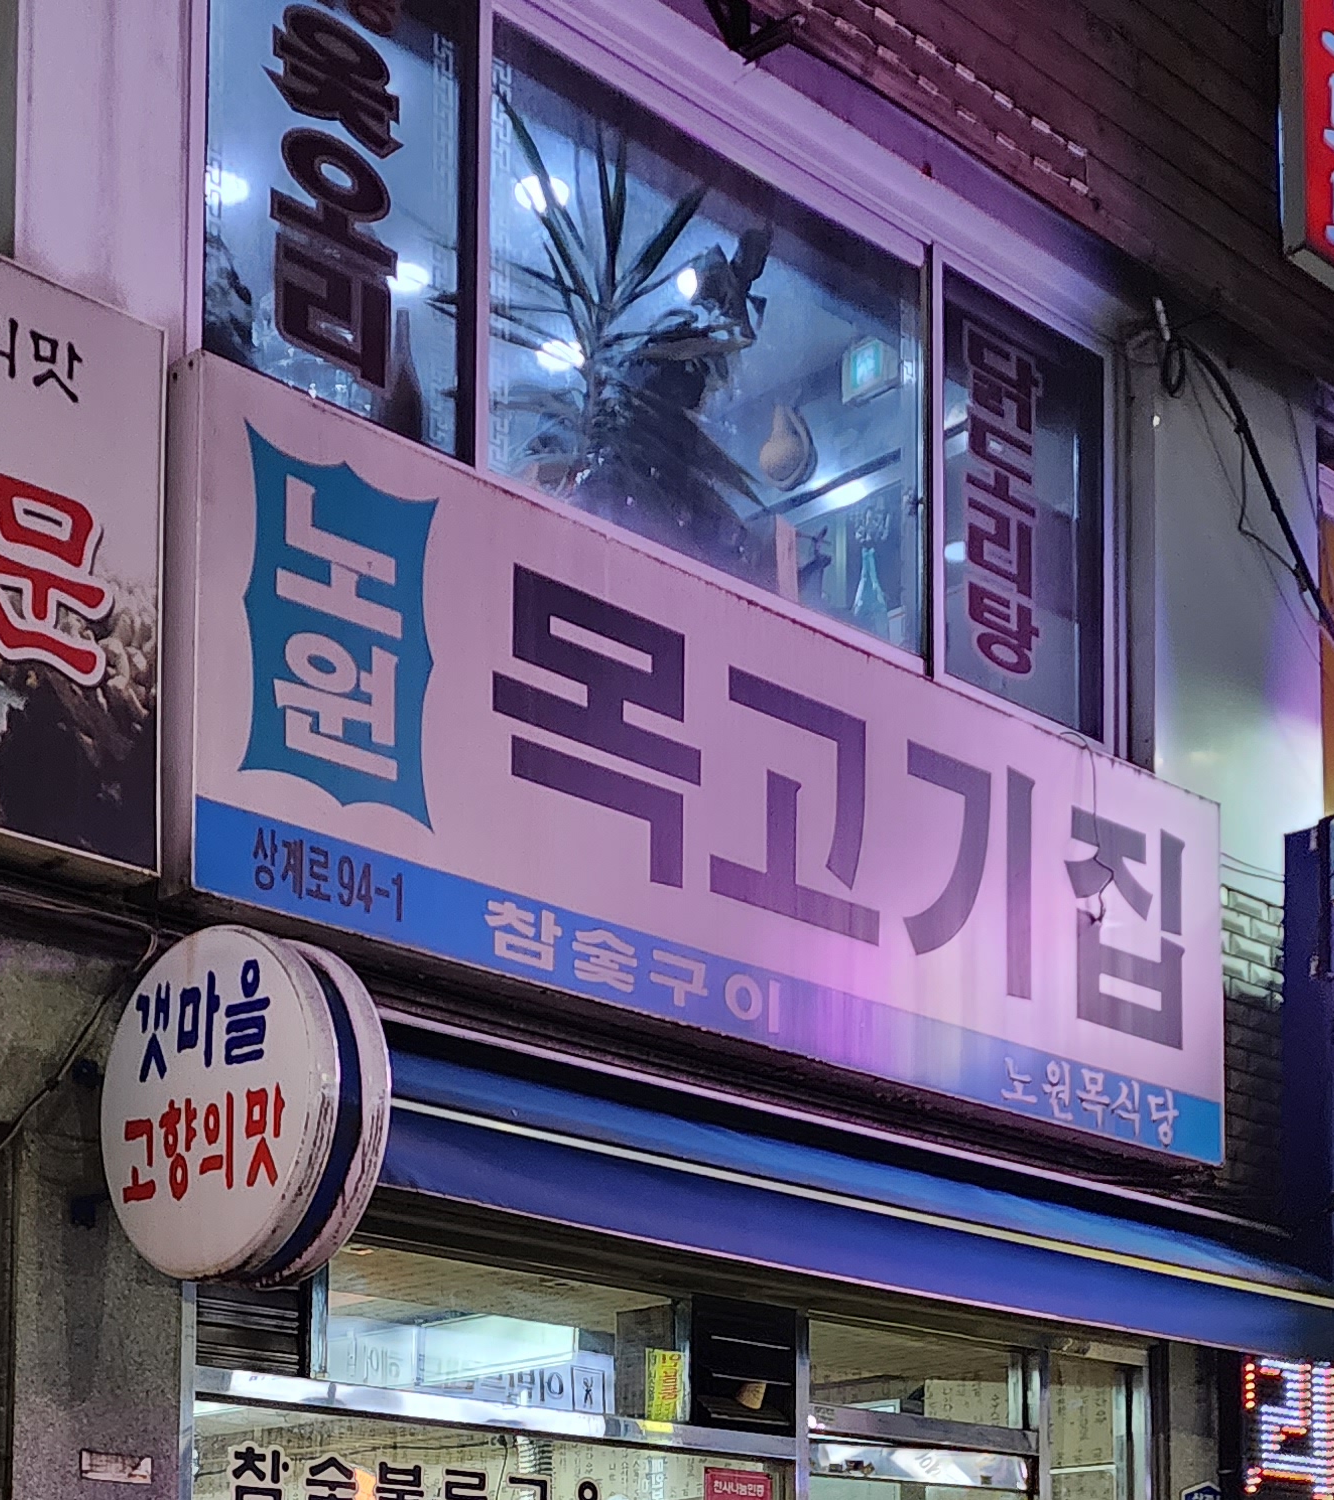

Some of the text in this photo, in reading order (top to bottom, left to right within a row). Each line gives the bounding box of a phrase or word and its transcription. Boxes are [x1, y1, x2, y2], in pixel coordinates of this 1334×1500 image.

[273, 476, 405, 784] 노원
[491, 561, 1187, 1054] 목고기집
[134, 958, 271, 1083] 갯마을
[482, 896, 783, 1037] 참숯구이
[122, 1081, 286, 1204] 고향의맛
[1001, 1056, 1180, 1146] 노원목식당
